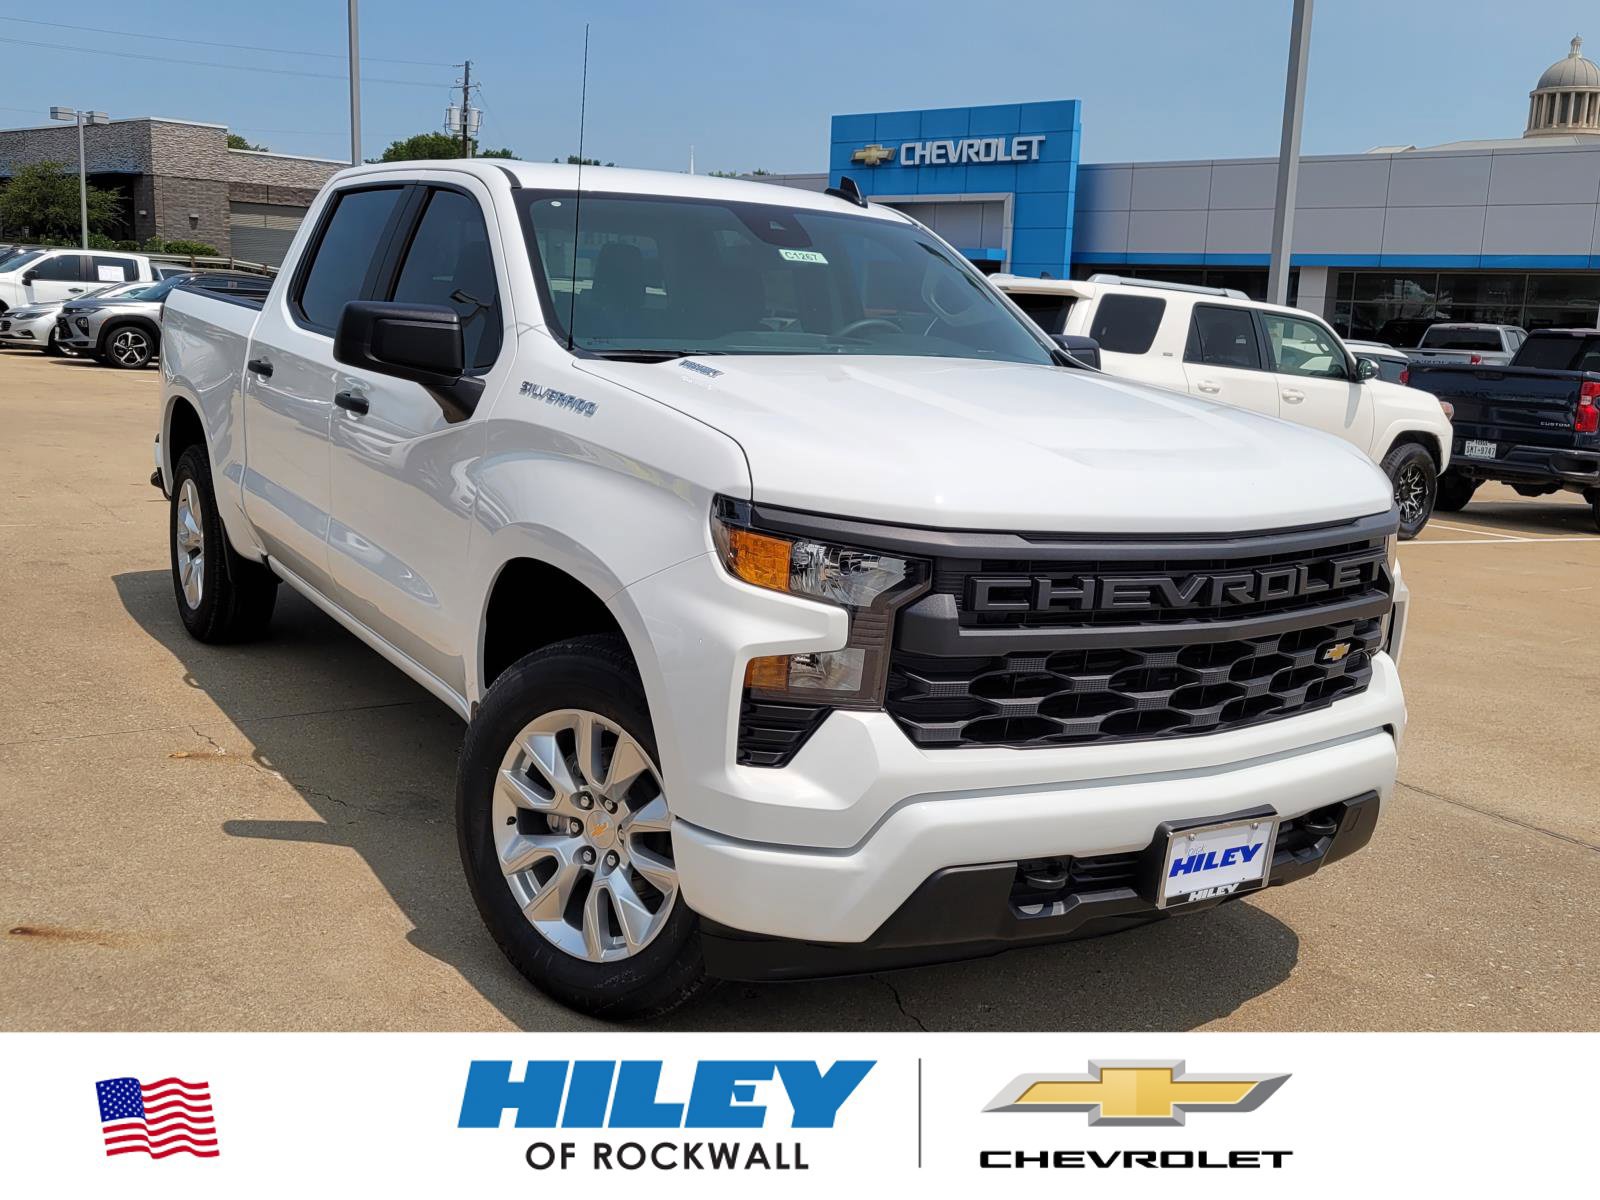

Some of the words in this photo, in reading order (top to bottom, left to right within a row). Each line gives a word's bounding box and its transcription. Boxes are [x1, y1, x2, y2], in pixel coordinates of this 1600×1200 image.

[900, 135, 1046, 166] CHEVROLET
[519, 381, 598, 418] SILVERADO
[971, 555, 1391, 612] CHEVROLET
[1169, 843, 1263, 878] HILEY
[1188, 883, 1239, 902] HILEY
